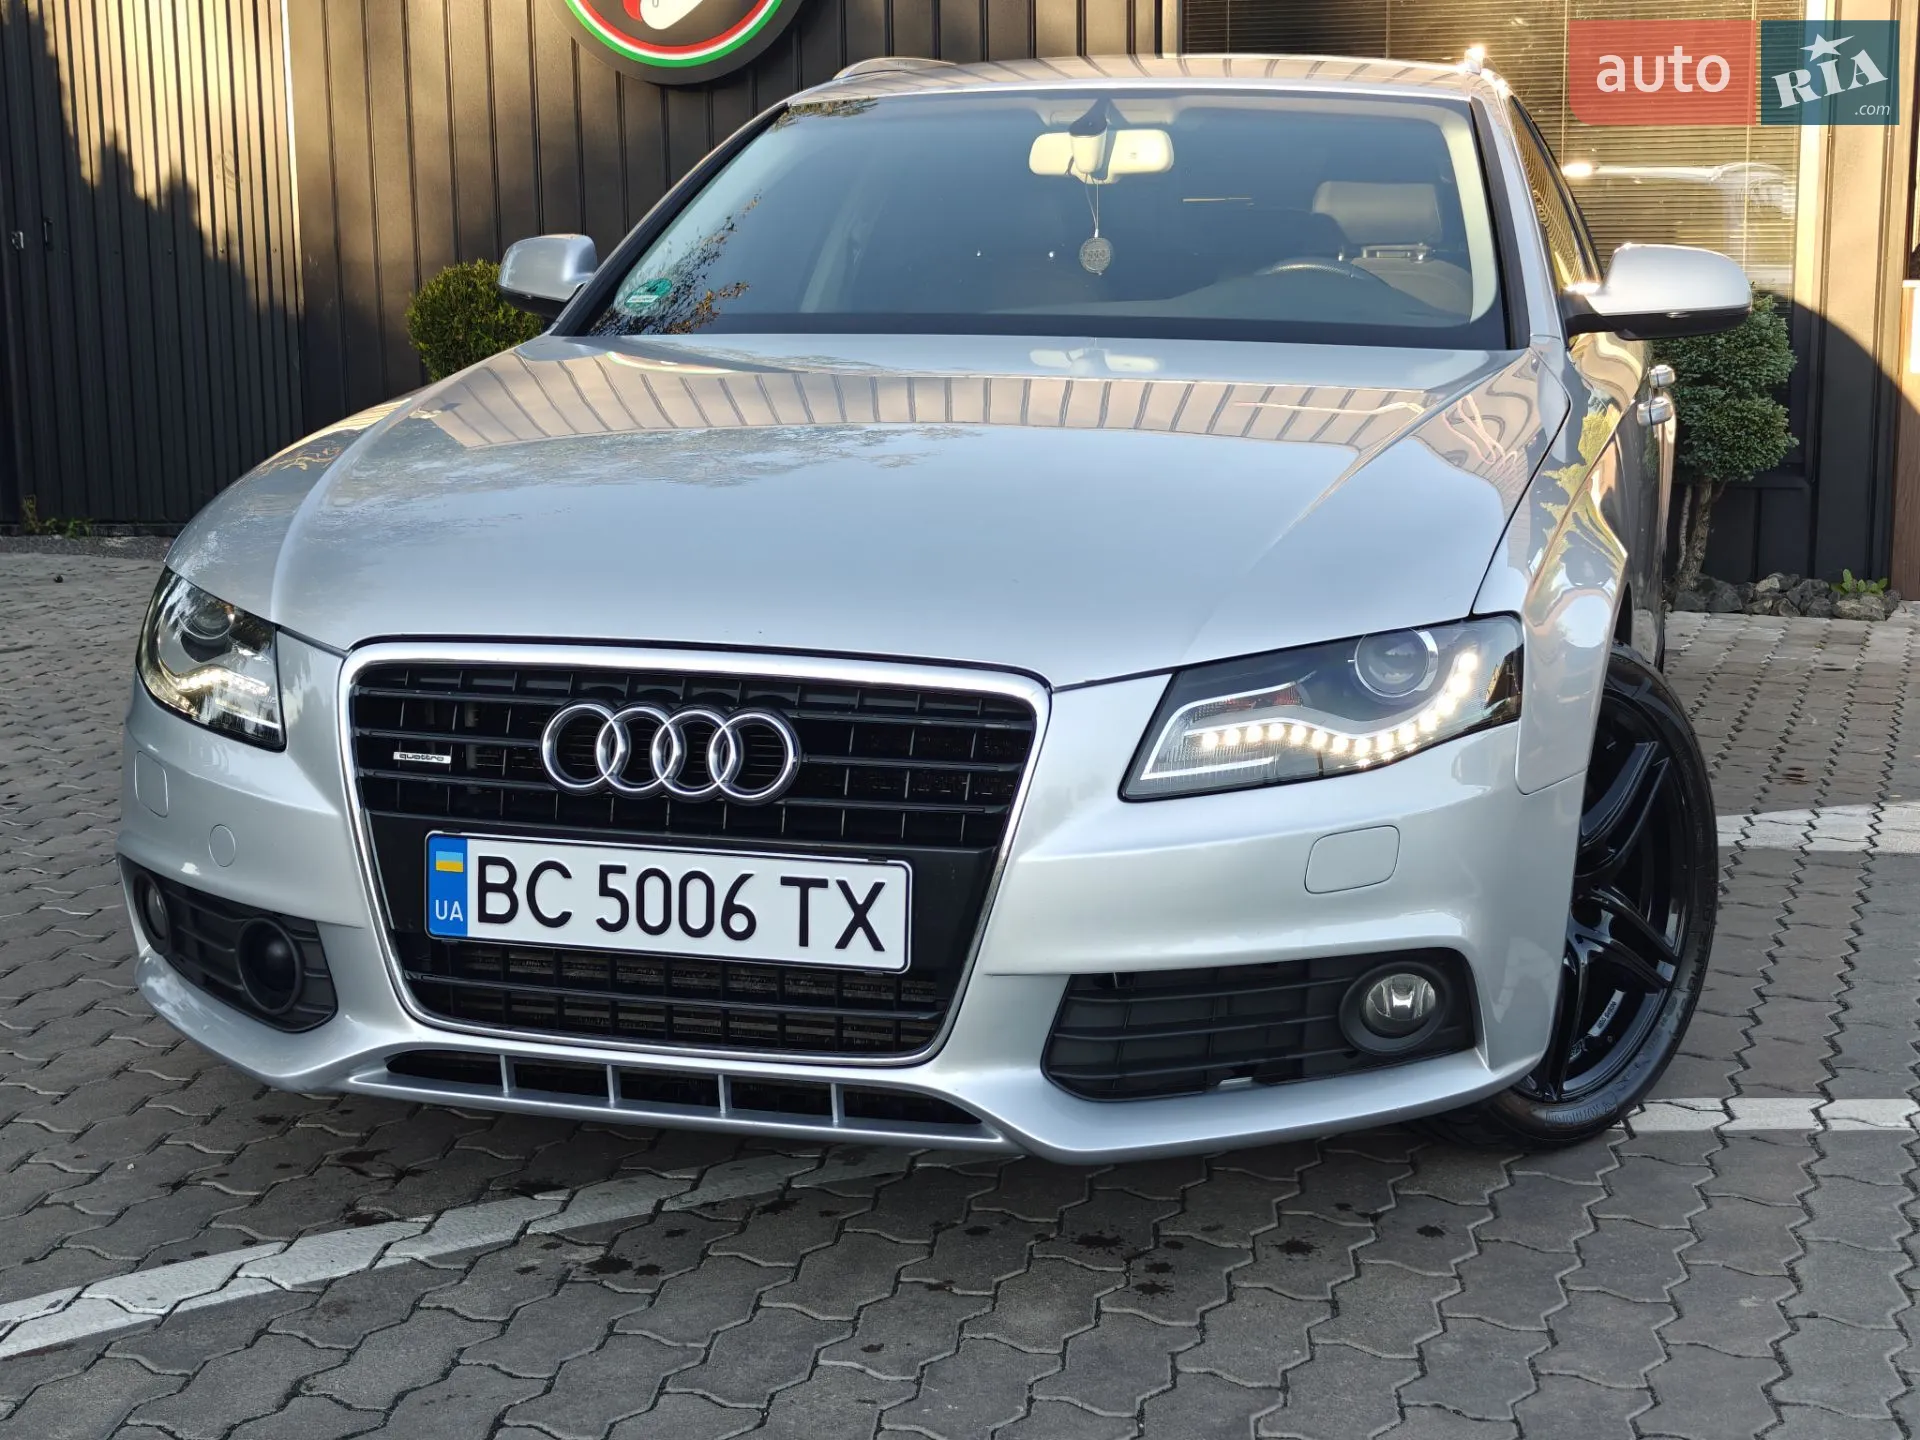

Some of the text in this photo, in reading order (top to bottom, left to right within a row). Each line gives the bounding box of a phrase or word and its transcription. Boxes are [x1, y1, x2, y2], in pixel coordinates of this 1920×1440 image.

[399, 753, 445, 761] quattro
[434, 899, 463, 922] UA
[477, 855, 886, 952] BC 5006 TX
